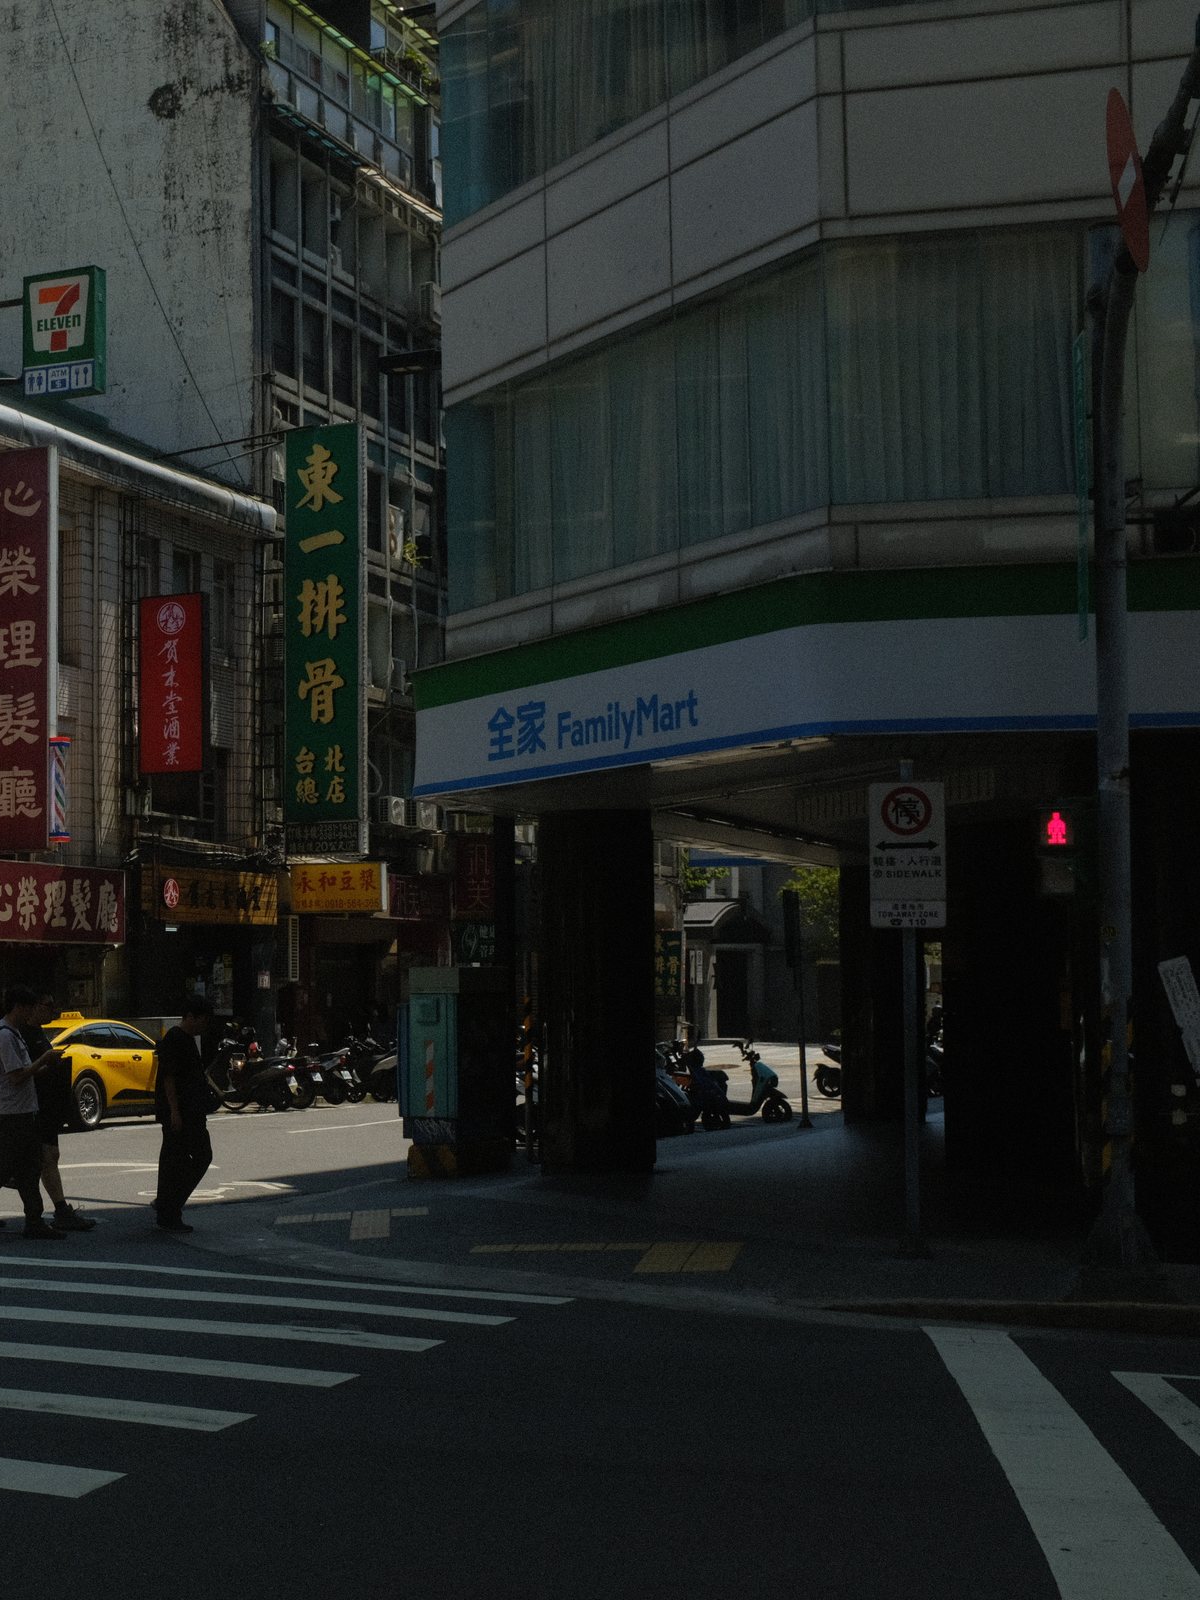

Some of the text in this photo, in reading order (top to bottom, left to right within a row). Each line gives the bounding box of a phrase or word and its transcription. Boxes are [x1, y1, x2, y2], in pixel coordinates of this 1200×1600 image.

[51, 369, 67, 378] ATM
[296, 443, 348, 725] 東一排骨
[488, 690, 698, 761] 全家 FamilyMart
[296, 868, 377, 893] 永和豆漿
[886, 869, 942, 879] SIDEWALK
[909, 918, 927, 926] 110
